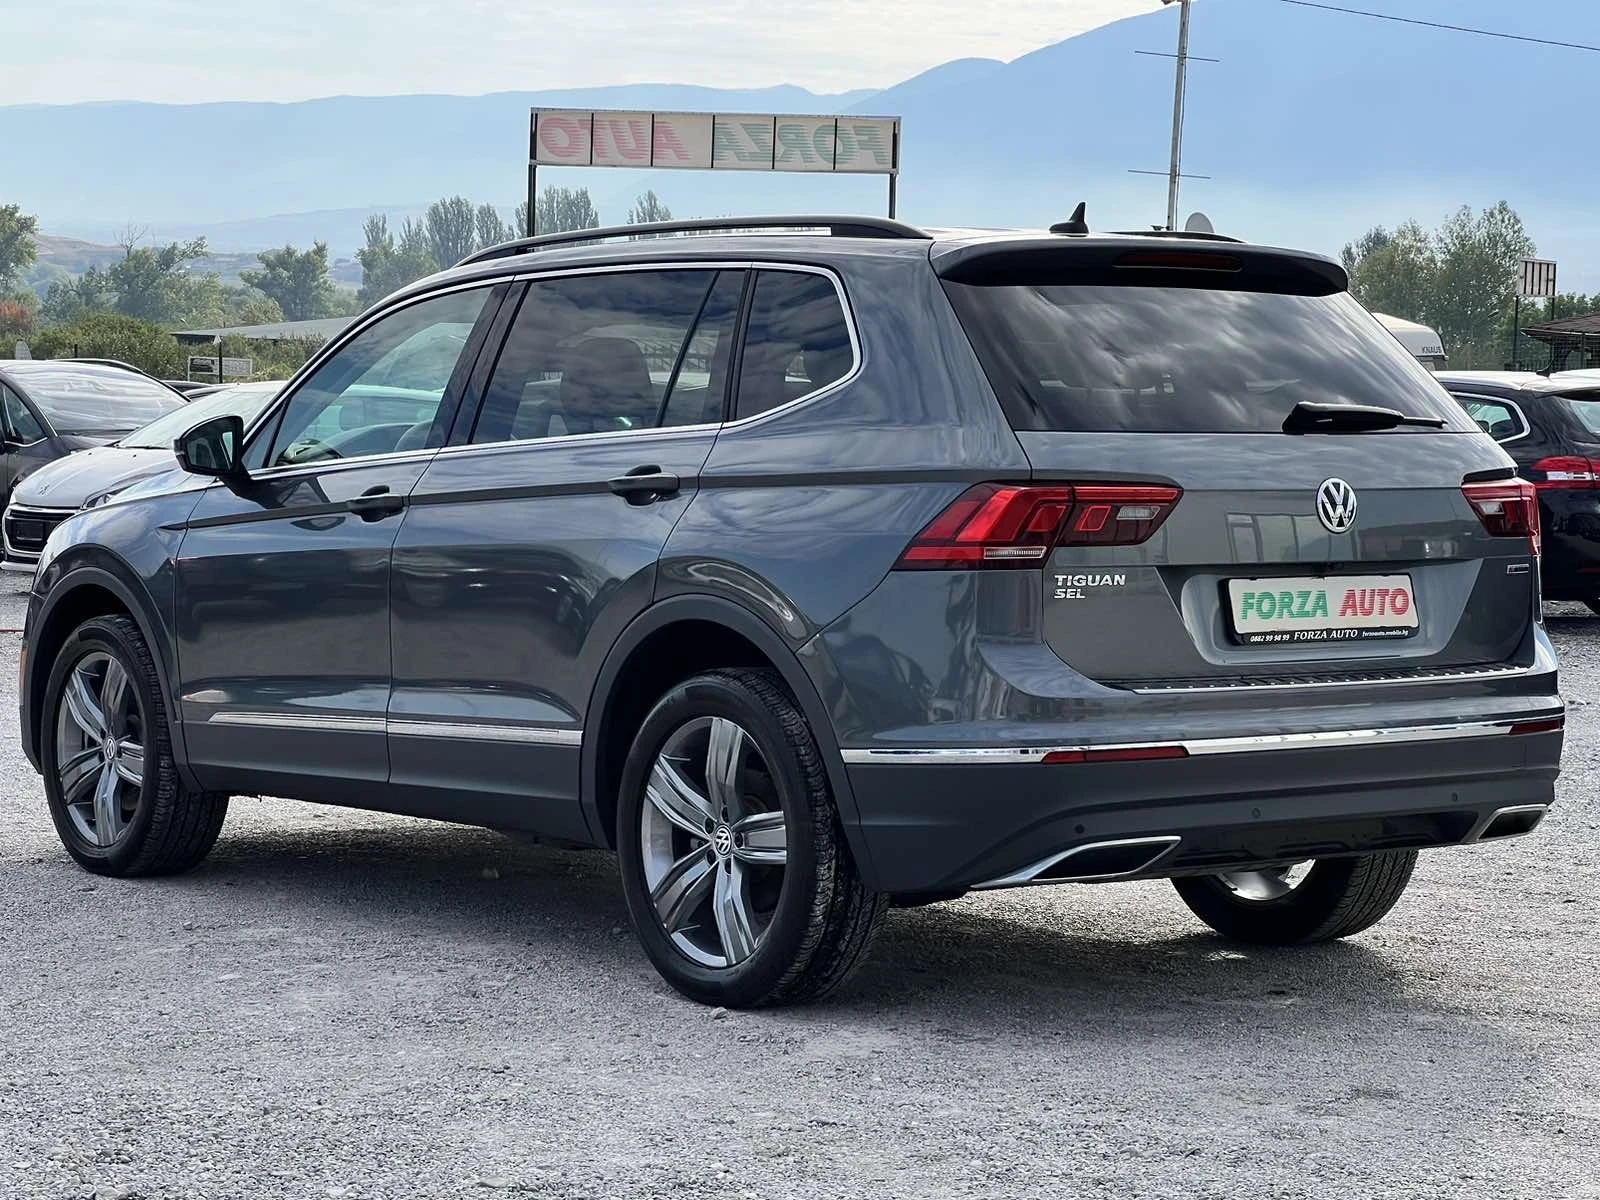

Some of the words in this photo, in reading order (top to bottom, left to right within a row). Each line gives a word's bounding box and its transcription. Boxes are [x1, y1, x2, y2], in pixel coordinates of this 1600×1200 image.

[1054, 574, 1127, 587] TIGUAN
[1053, 588, 1086, 599] SEL
[1241, 590, 1328, 621] FORZA
[1338, 587, 1410, 618] AUTO
[1294, 630, 1327, 640] FORZA
[1330, 629, 1358, 639] AUTO
